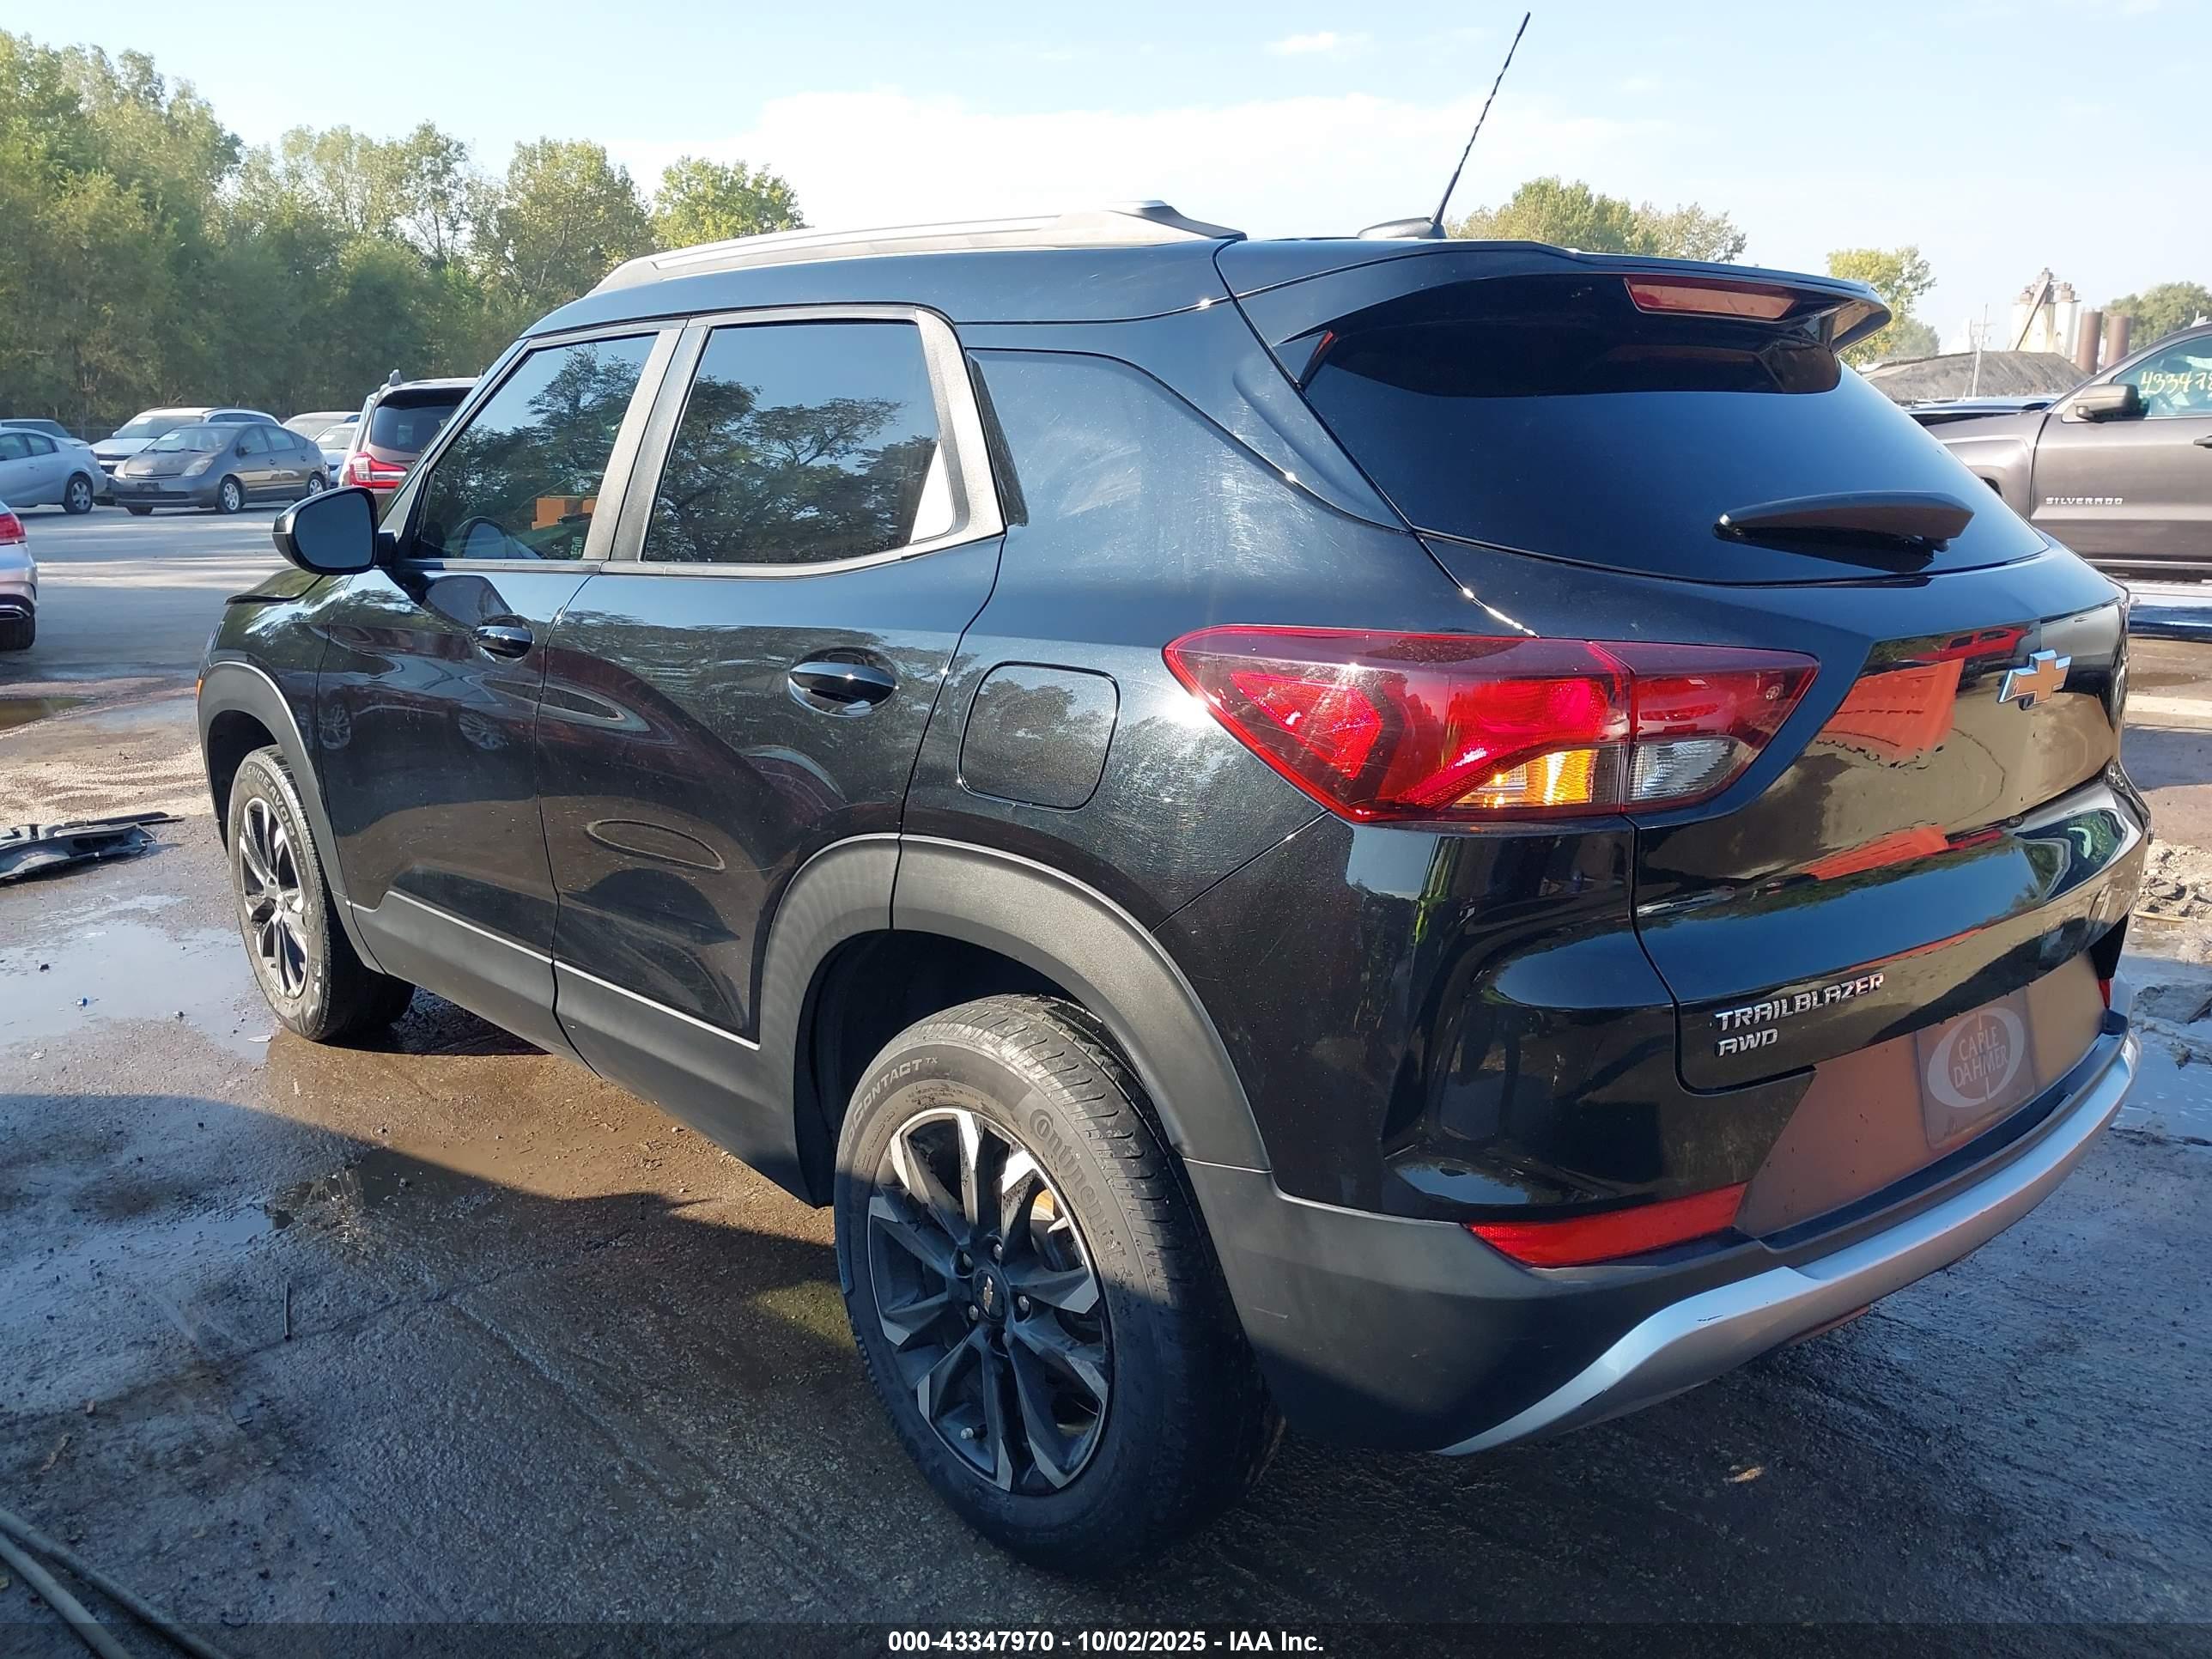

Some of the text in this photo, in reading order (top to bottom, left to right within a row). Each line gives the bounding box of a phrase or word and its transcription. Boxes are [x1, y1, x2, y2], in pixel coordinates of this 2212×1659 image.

[2045, 497, 2124, 506] SILVERADO
[246, 765, 295, 837] ENDEAVOR
[1714, 972, 1885, 1031] TRAILBLAZER
[1717, 1028, 1778, 1057] AWD
[1954, 1044, 2008, 1089] DAHMER
[1030, 1109, 1127, 1257] Continental
